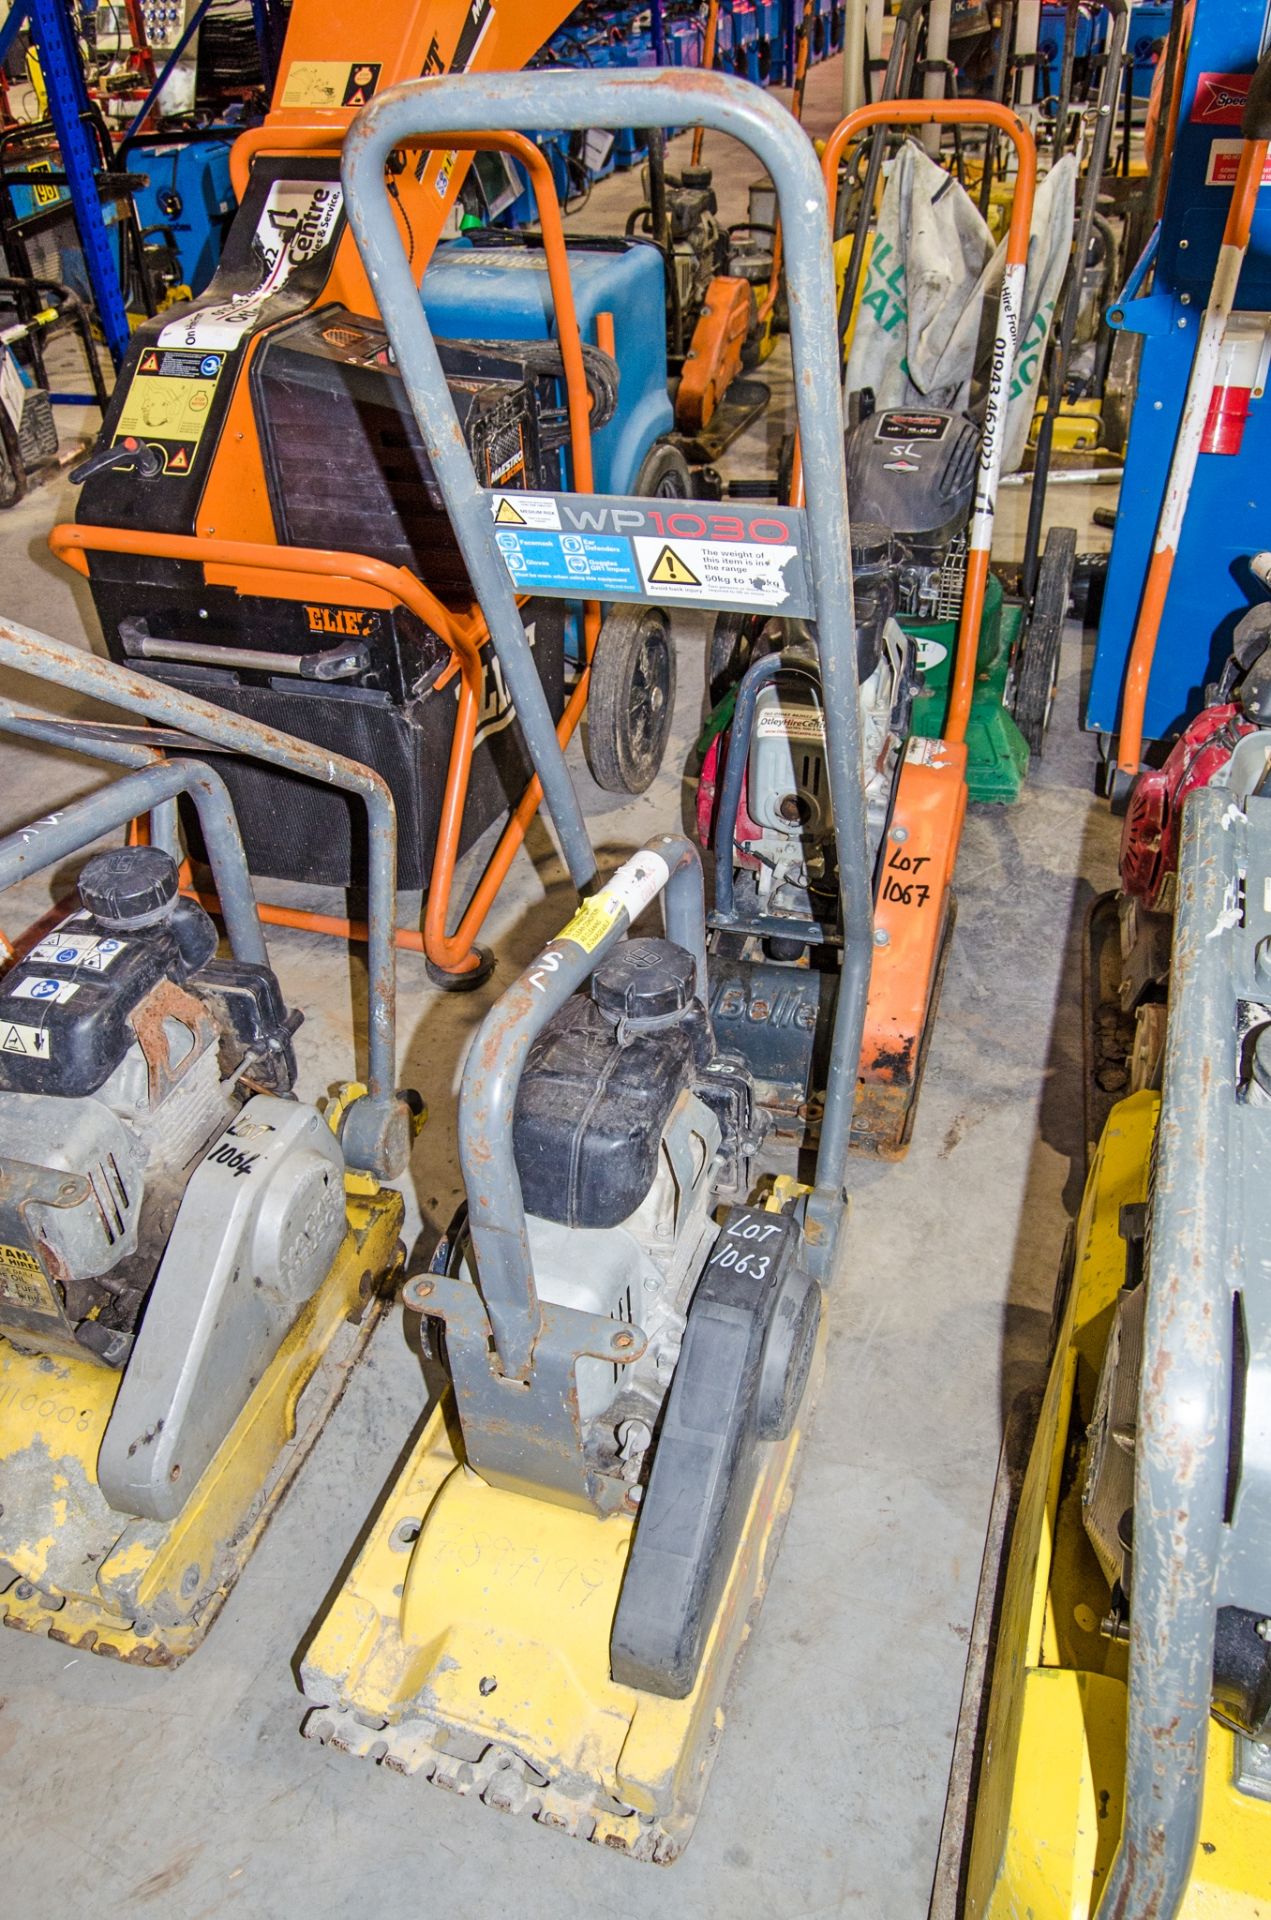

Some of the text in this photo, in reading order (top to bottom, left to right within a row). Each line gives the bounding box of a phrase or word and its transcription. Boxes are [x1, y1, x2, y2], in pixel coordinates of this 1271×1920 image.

[1217, 92, 1248, 108] Spee
[288, 188, 331, 266] Centre
[562, 506, 789, 545] WP1030
[720, 551, 753, 559] weight
[705, 575, 731, 584] 50kg
[882, 875, 931, 908] 1067
[207, 1143, 261, 1177] 1064
[727, 1214, 783, 1242] LOT
[710, 1243, 771, 1279] 1063
